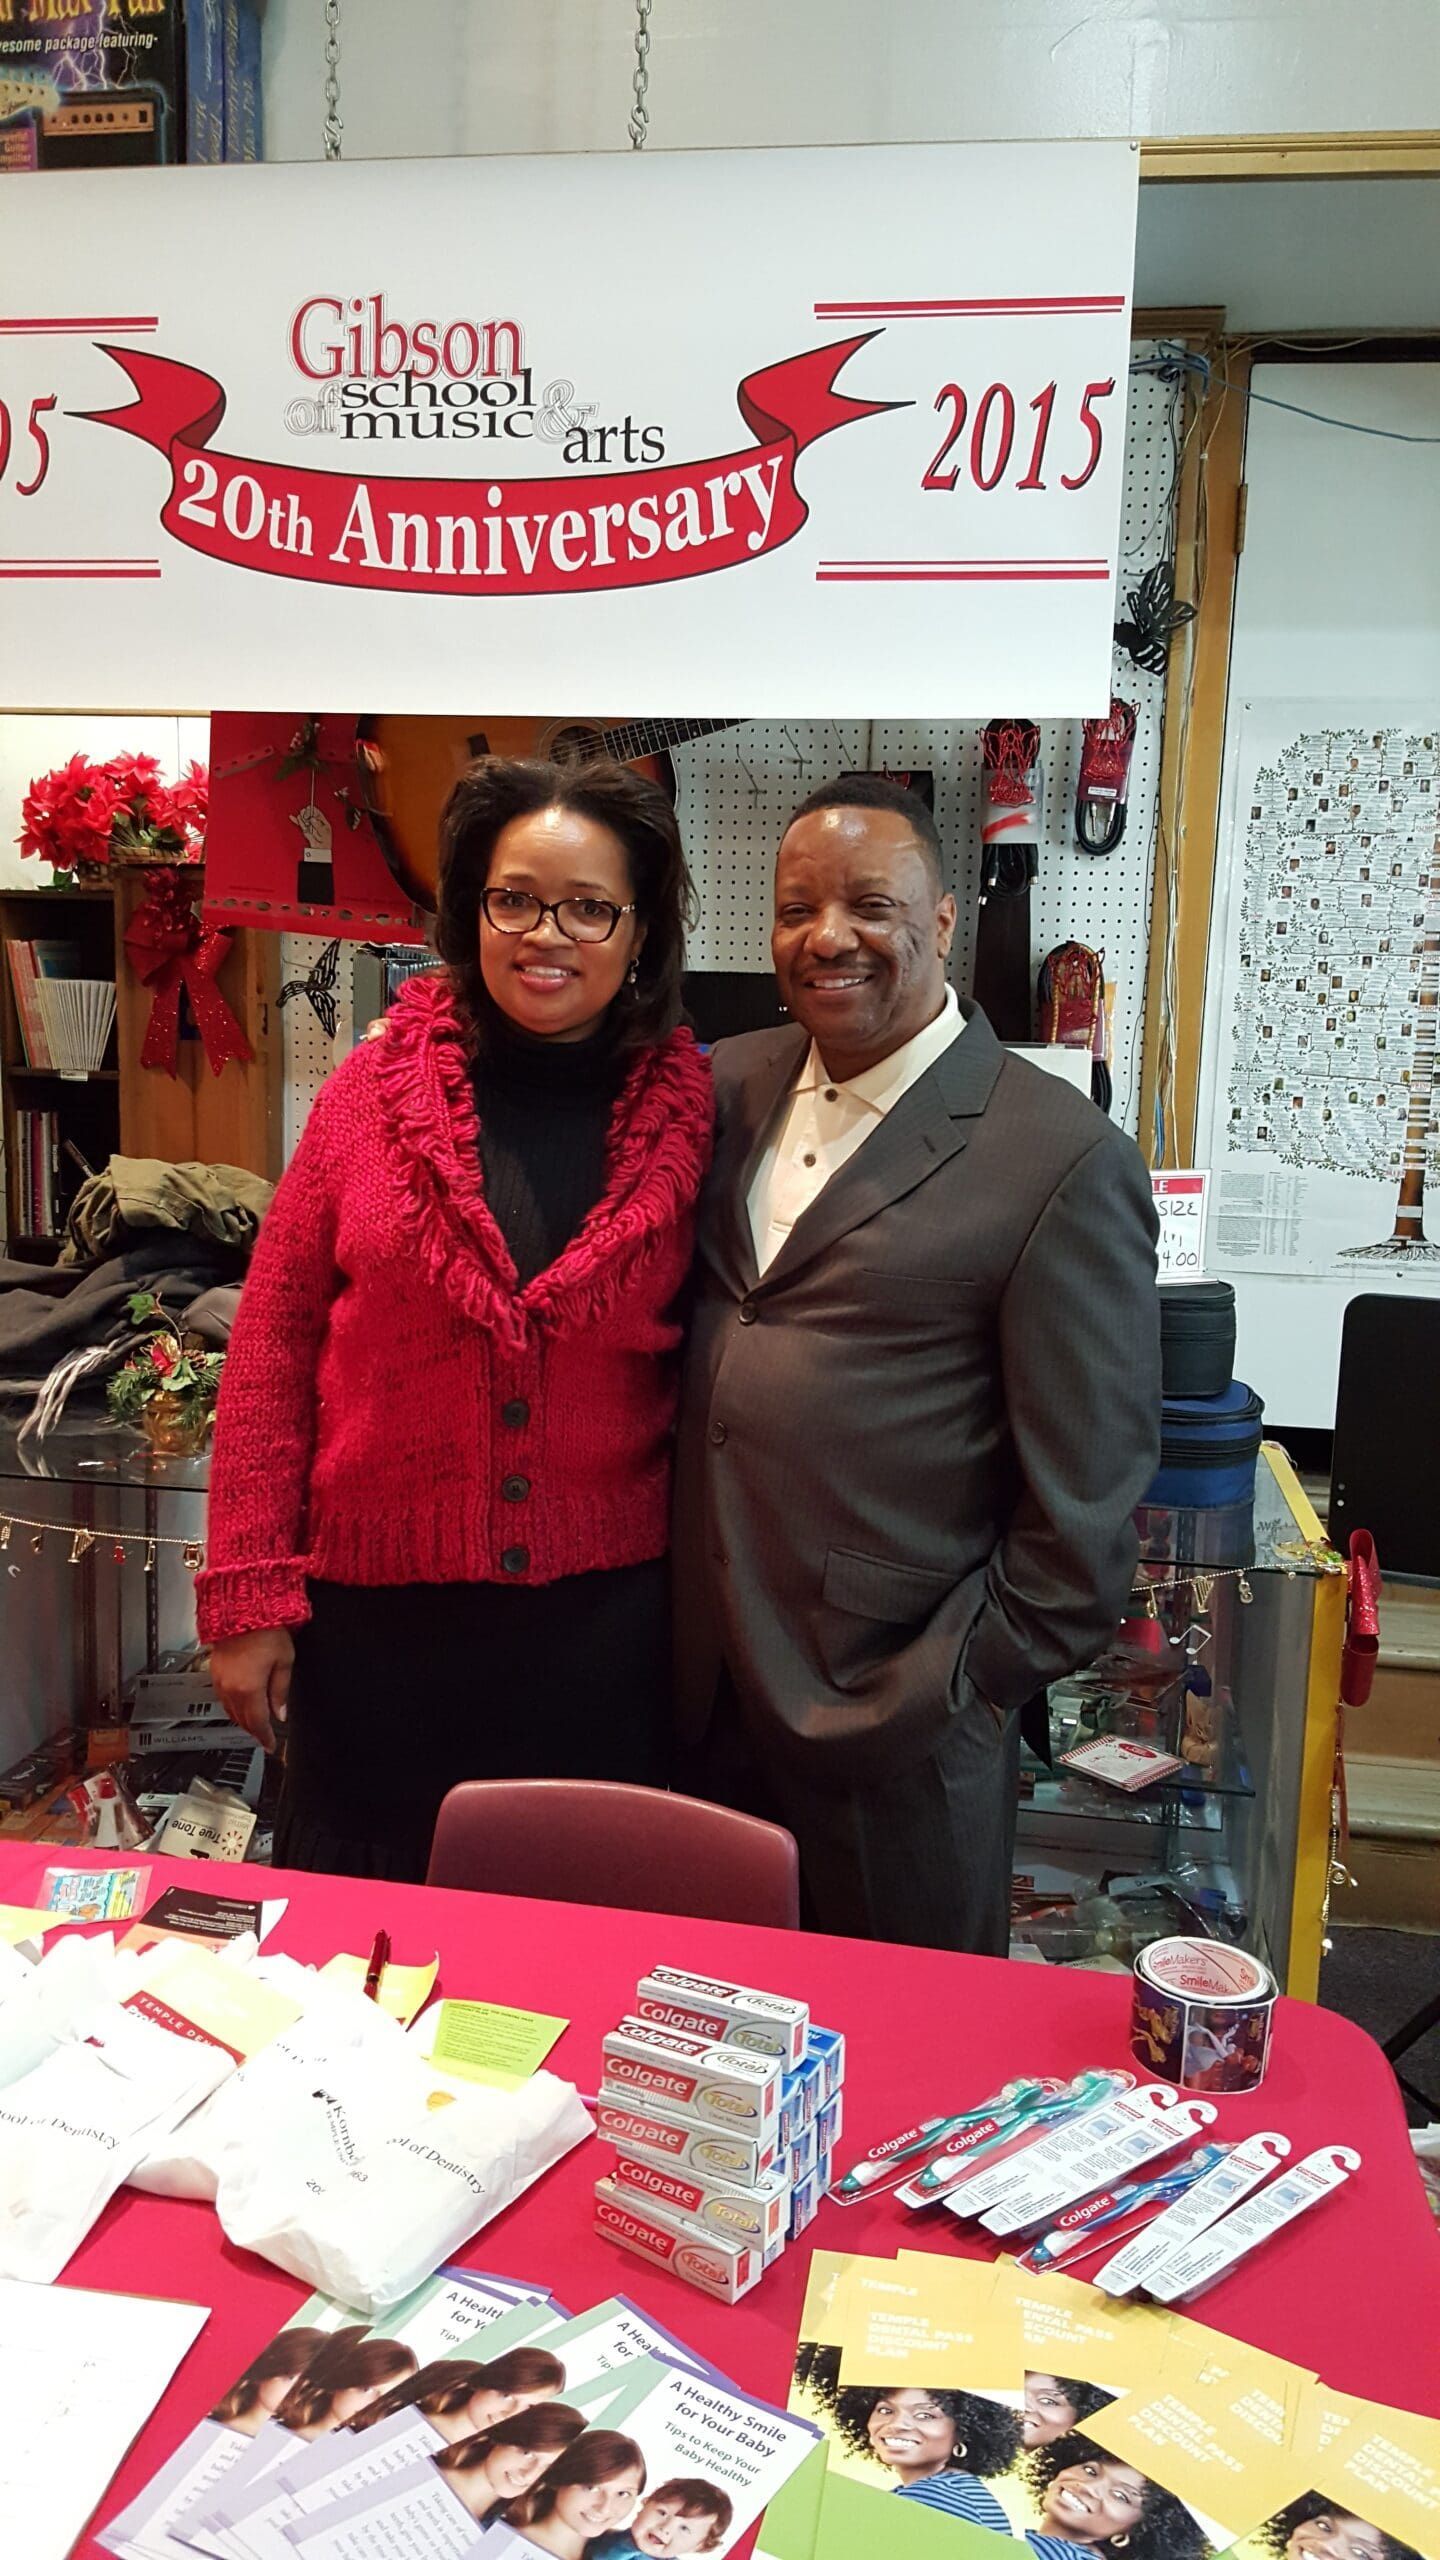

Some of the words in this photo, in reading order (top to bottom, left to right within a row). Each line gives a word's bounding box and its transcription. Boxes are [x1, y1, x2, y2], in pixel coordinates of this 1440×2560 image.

[0, 39, 42, 53] esome
[45, 34, 95, 54] package
[290, 292, 526, 381] Gibson
[340, 368, 537, 409] school
[283, 379, 341, 438] of
[339, 409, 535, 440] music
[562, 415, 666, 464] arts
[920, 376, 1116, 491] 2015
[177, 458, 314, 556] 20th
[328, 453, 783, 576] Anniversary
[1158, 1200, 1198, 1217] SIZE
[171, 1819, 198, 1837] Tone
[198, 1828, 221, 1844] True
[650, 1970, 730, 1997] Colgate
[1180, 1974, 1230, 1994] SmileMak
[139, 1997, 183, 2030] TEMPLE
[639, 2001, 719, 2035] Colgate
[618, 2023, 702, 2053] Colgate
[606, 2057, 689, 2094] Colgate
[600, 2110, 680, 2147] Colgate
[867, 2127, 919, 2159] Colgate
[946, 2122, 996, 2153] Colgate
[408, 2144, 429, 2156] of
[425, 2149, 486, 2195] Dentistry
[618, 2161, 695, 2204] Colgate
[712, 2202, 761, 2233] Total
[1059, 2195, 1112, 2227] Colgate
[596, 2204, 669, 2250] Colgate
[681, 2251, 729, 2285] Total
[446, 2291, 458, 2302] A
[459, 2296, 504, 2320] Healt
[450, 2310, 473, 2325] for
[869, 2311, 930, 2329] TEMPLE
[1014, 2296, 1073, 2318] TEMPLE
[440, 2328, 461, 2343] Tips
[617, 2321, 630, 2332] A
[868, 2323, 929, 2339] DENTAL
[934, 2330, 974, 2344] PASS
[1023, 2309, 1070, 2330] ENTAL
[1076, 2323, 1116, 2341] PASS
[1023, 2320, 1088, 2345] SCOUNT
[613, 2341, 634, 2358] for
[865, 2344, 909, 2359] PLAN
[867, 2334, 950, 2351] DISCOUNT
[670, 2381, 682, 2392] A
[683, 2387, 743, 2422] Healthy
[743, 2416, 787, 2442] Smile
[1162, 2394, 1217, 2438] TEMPLE
[675, 2402, 699, 2419] for
[701, 2413, 735, 2437] Your
[736, 2432, 776, 2458] Baby
[1127, 2414, 1169, 2446] PLAN
[1138, 2407, 1214, 2463] DISCOUNT
[1150, 2400, 1204, 2444] DENTAL
[1203, 2441, 1246, 2473] PASS
[664, 2421, 687, 2439] Tips
[689, 2434, 701, 2446] to
[702, 2441, 733, 2462] Keep
[734, 2456, 761, 2475] Your
[1371, 2433, 1435, 2480] TEMPLE
[675, 2443, 706, 2464] Baby
[705, 2458, 752, 2488] Healthy
[1343, 2460, 1390, 2494] PLAN
[1353, 2450, 1439, 2509] DISCOUNT
[1361, 2442, 1424, 2487] DENTAL
